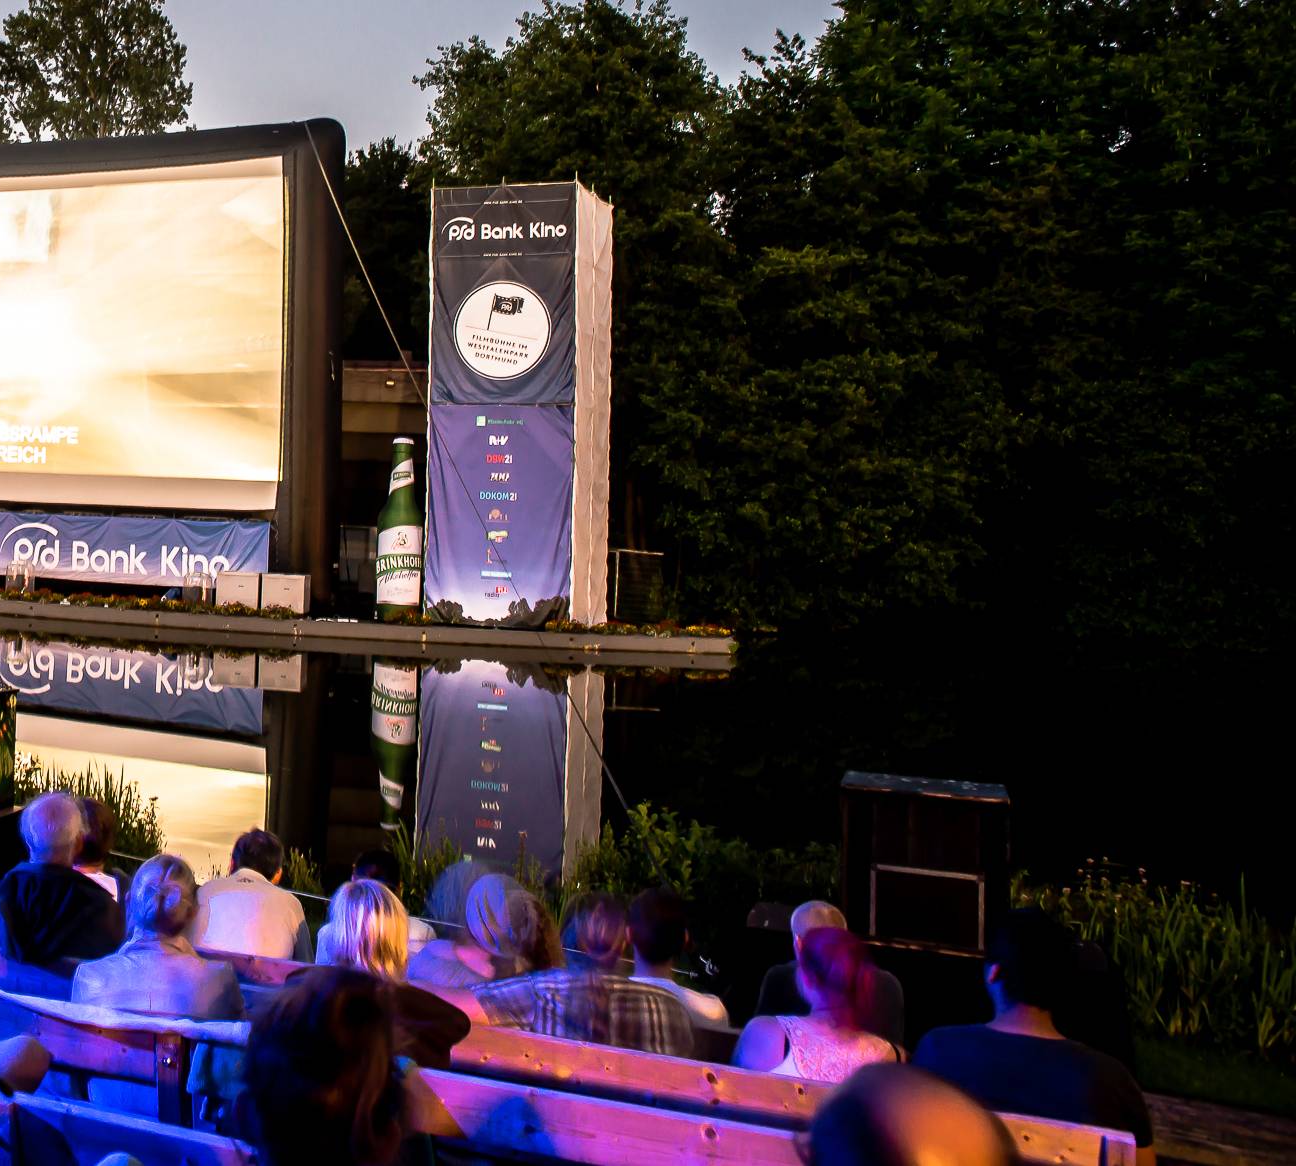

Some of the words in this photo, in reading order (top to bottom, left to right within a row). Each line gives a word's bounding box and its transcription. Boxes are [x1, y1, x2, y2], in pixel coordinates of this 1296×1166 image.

[481, 221, 524, 240] Bank
[529, 221, 567, 239] Kino
[479, 491, 517, 501] DOKOM21
[71, 540, 148, 575] Bank
